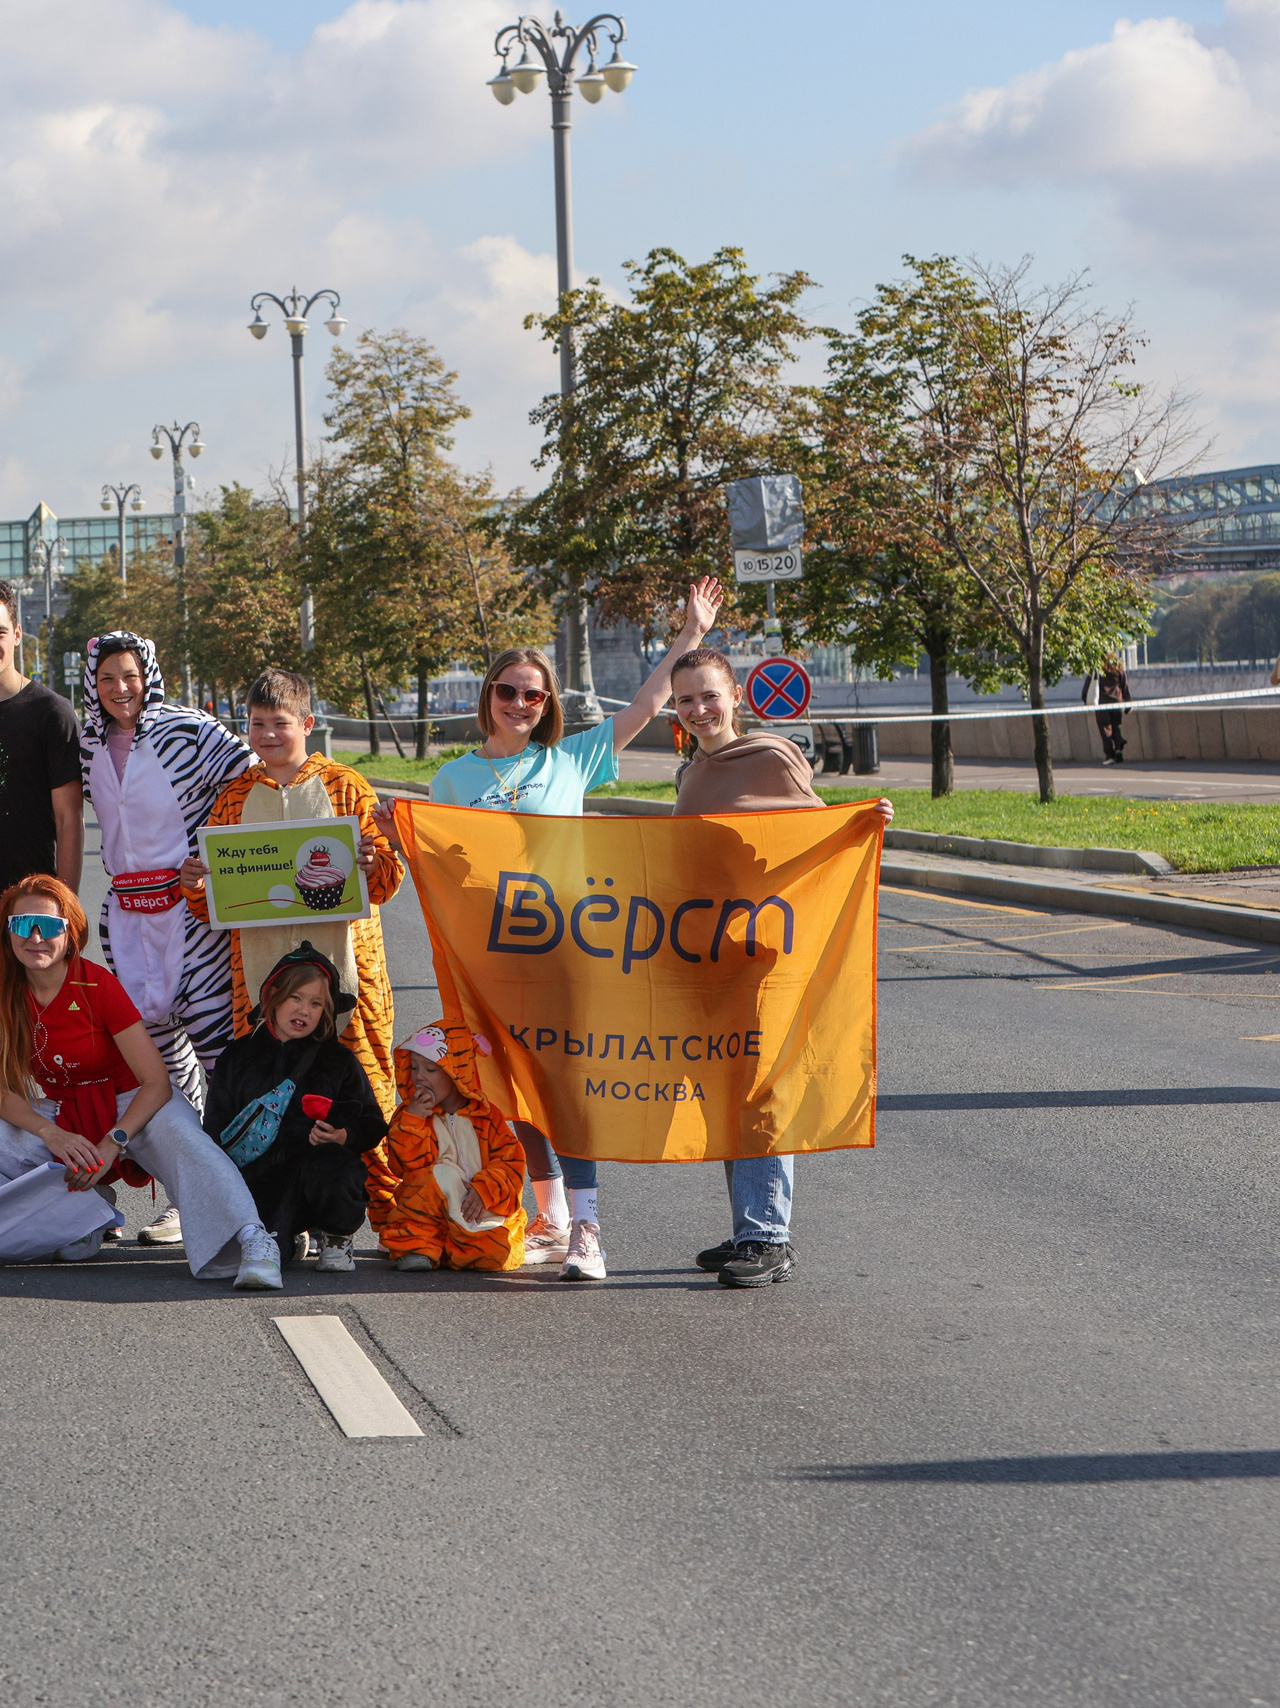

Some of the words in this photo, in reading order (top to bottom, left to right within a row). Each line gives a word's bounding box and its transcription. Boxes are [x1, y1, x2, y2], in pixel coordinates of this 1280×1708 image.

[743, 561, 753, 571] 10
[757, 559, 769, 571] 15
[774, 556, 794, 570] 20
[217, 847, 247, 858] Жду
[249, 844, 278, 856] тебя
[219, 867, 234, 875] на
[237, 860, 294, 875] финише!
[122, 896, 132, 908] 5
[133, 895, 169, 909] вёрст
[509, 1024, 764, 1062] КРЫЛАТСКОЕ
[585, 1078, 706, 1102] МОСКВА
